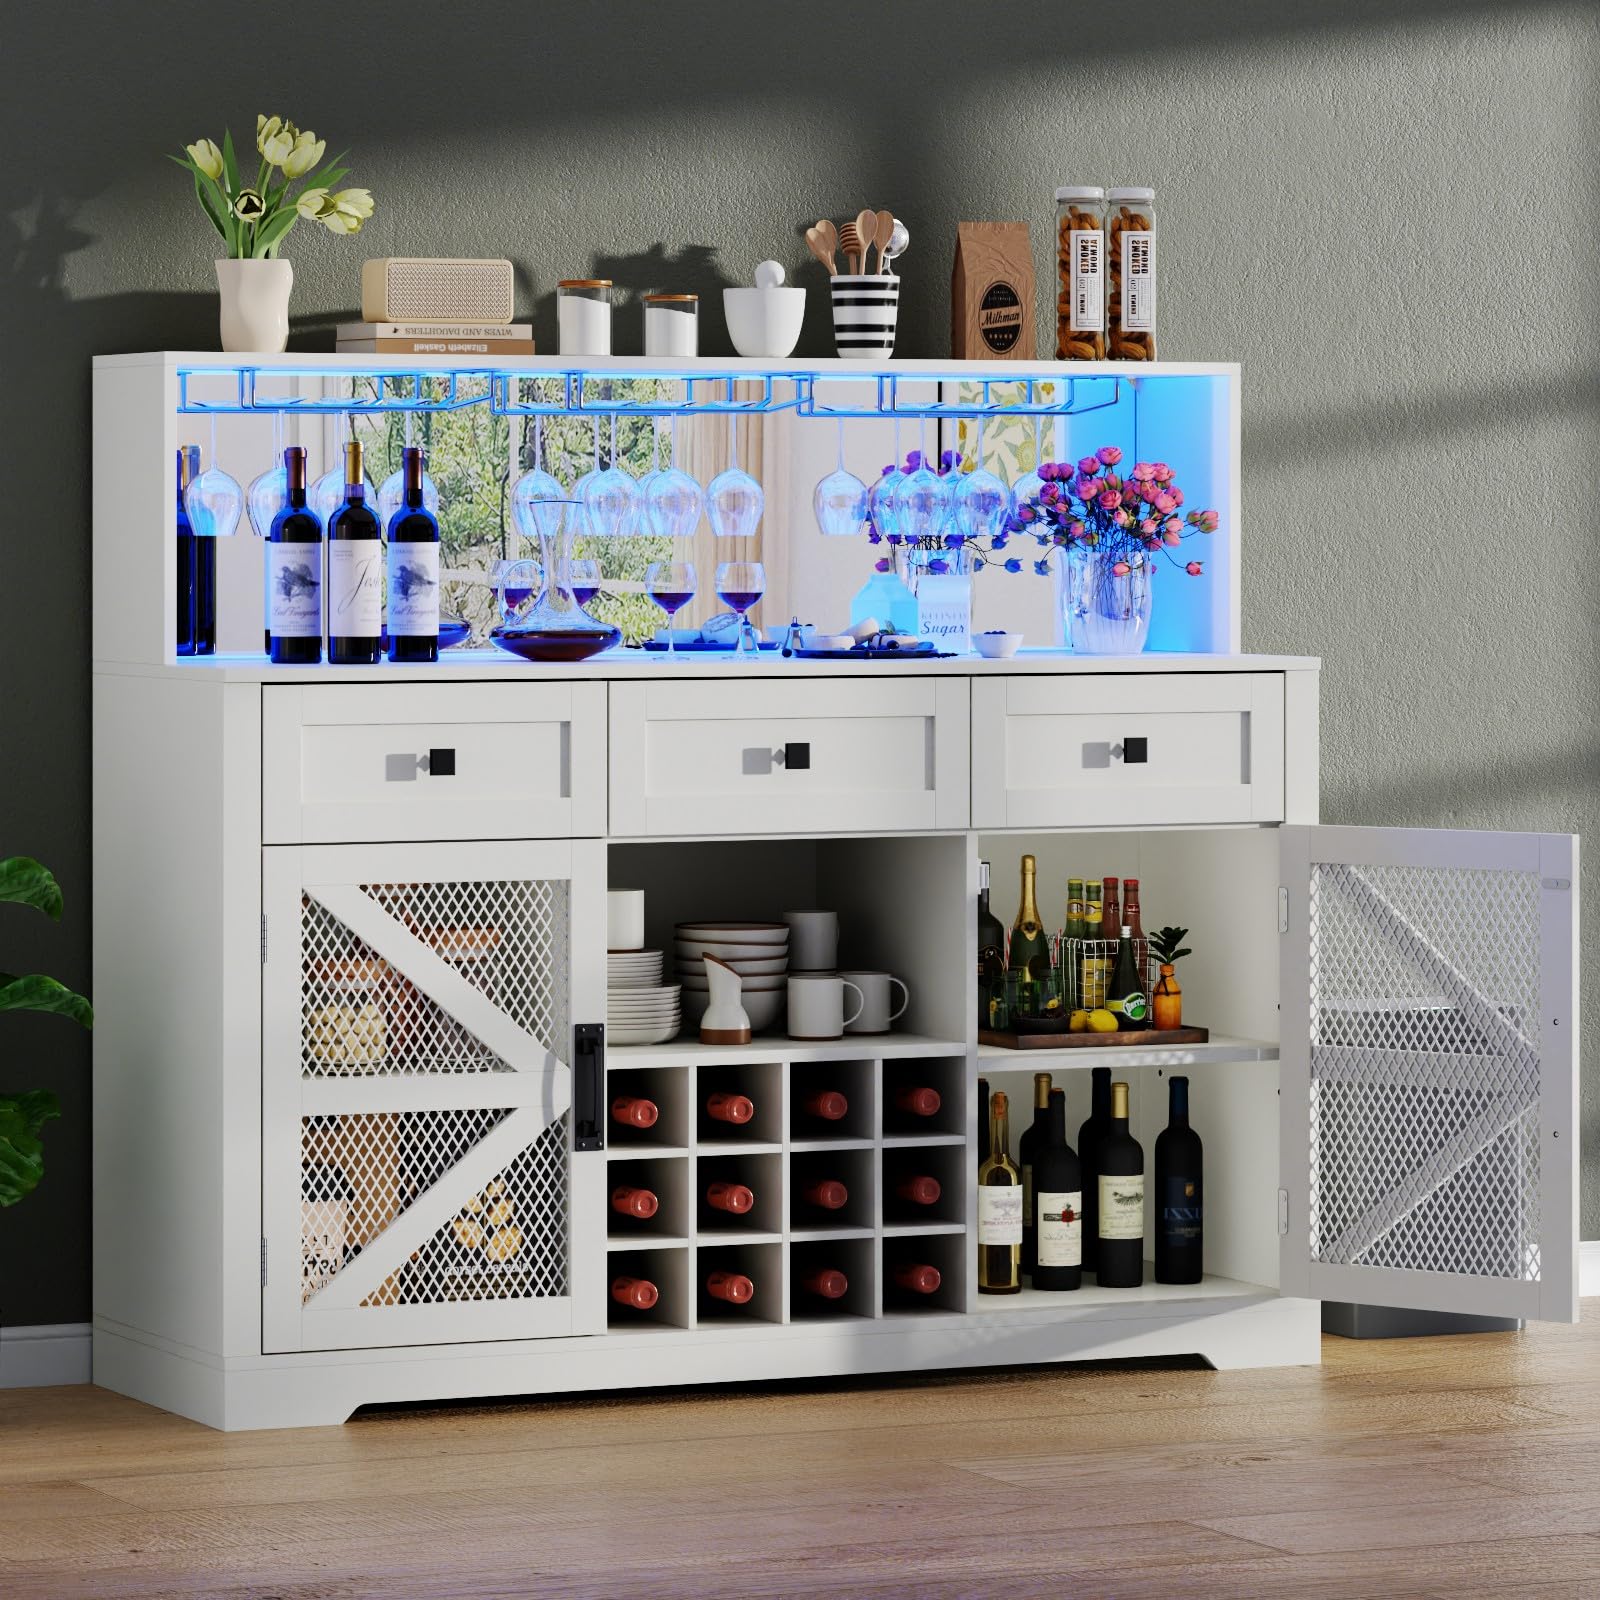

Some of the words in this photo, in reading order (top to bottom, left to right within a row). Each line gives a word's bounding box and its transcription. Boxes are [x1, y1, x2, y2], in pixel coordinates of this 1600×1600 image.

[981, 311, 1020, 326] Milkman
[404, 327, 460, 337] DAUGHTERS
[462, 327, 482, 337] AND
[484, 327, 513, 337] WIVES
[413, 343, 446, 352] Gaskell
[447, 343, 488, 352] Elizabeth
[921, 621, 965, 636] Sugar
